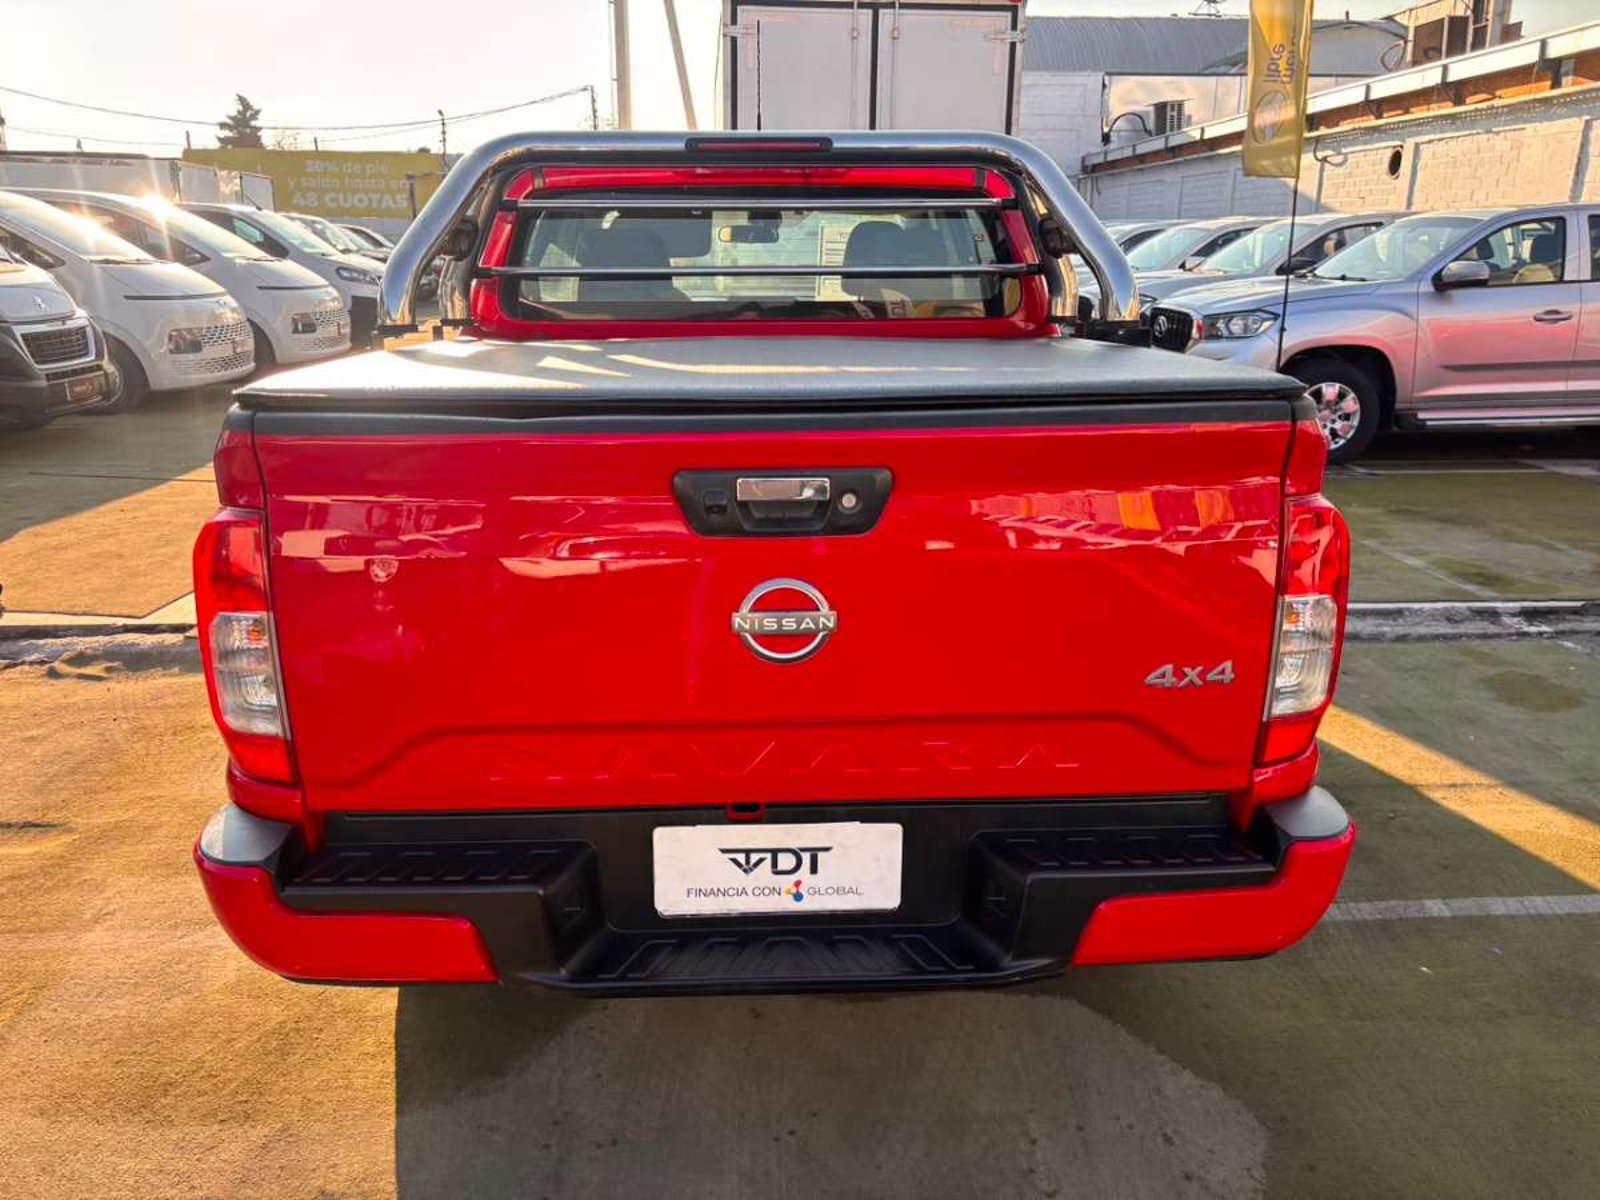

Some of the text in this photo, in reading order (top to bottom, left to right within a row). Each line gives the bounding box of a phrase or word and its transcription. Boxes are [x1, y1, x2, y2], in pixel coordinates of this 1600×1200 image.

[342, 160, 362, 173] de
[292, 192, 407, 208] 48 CUOTAS
[734, 615, 834, 632] NISSAN
[1144, 660, 1235, 688] 4x4
[686, 886, 863, 898] FINANCIA CON GLOBAL
